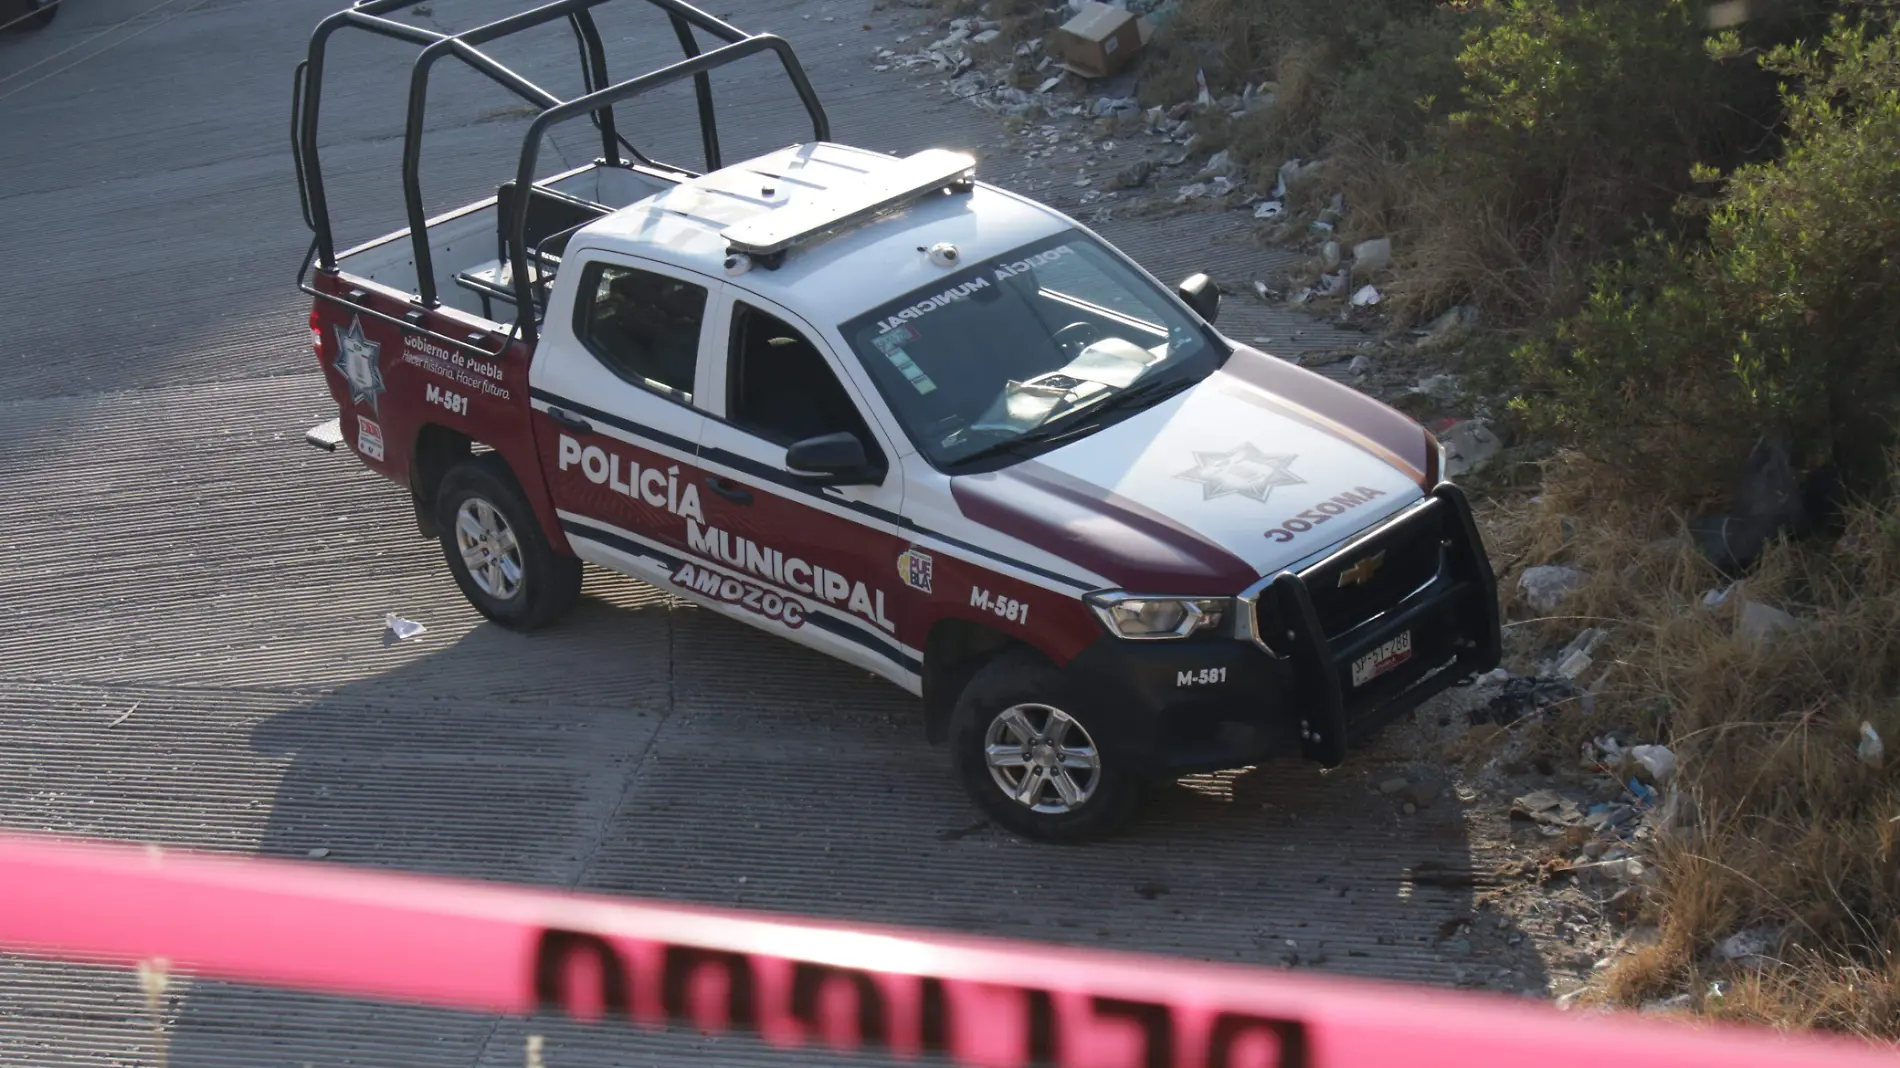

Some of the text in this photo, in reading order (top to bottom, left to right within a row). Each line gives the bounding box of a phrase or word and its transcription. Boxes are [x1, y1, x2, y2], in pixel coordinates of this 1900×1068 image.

[402, 350, 422, 368] Hacer
[456, 371, 480, 389] Hacer
[482, 380, 510, 400] futuro.
[404, 336, 503, 381] Gobierno de Puebla
[426, 383, 468, 415] M-581
[559, 433, 706, 525] POLICÍA
[671, 562, 803, 626] AMOZOC
[687, 517, 895, 633] MUNICIPAL
[970, 585, 1029, 625] M-581
[1177, 667, 1226, 687] M-581
